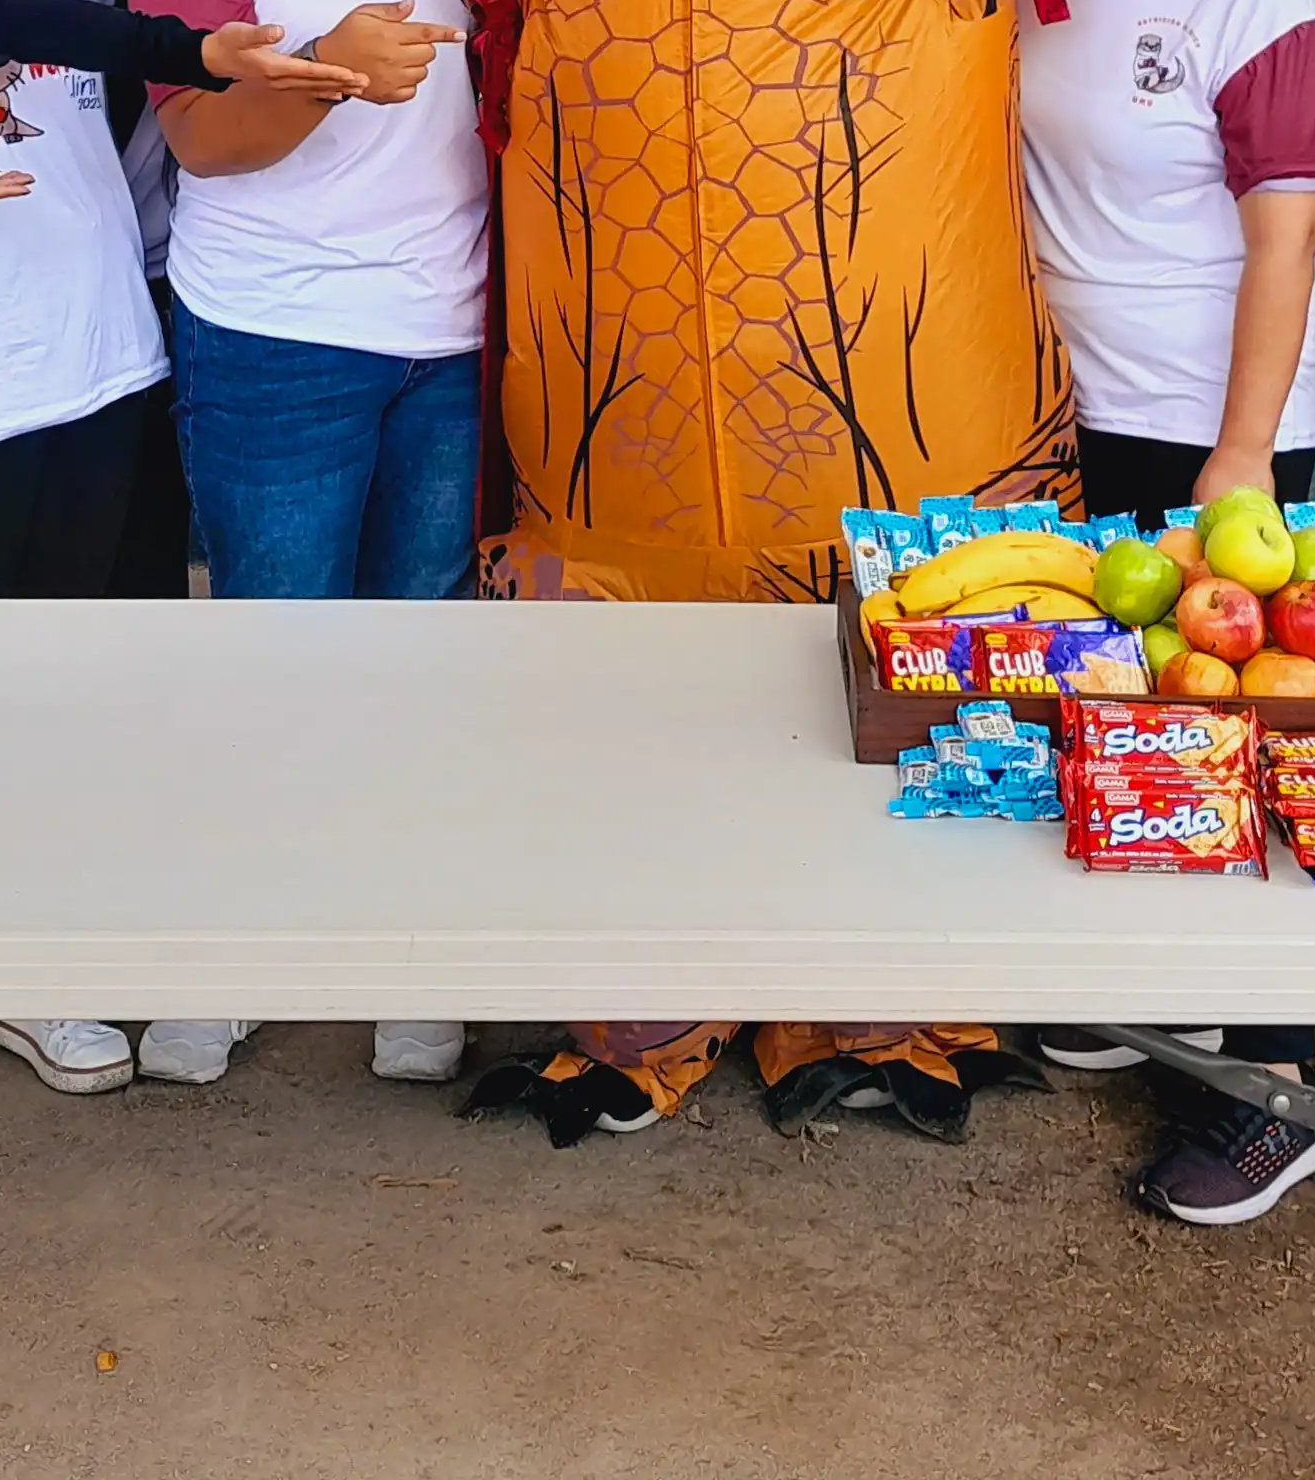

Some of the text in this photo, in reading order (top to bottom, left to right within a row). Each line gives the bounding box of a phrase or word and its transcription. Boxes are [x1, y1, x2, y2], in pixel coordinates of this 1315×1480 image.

[891, 647, 948, 676] CLUB
[989, 649, 1046, 677] CLUB
[1103, 722, 1212, 757] Soda
[1109, 805, 1223, 847] Soda
